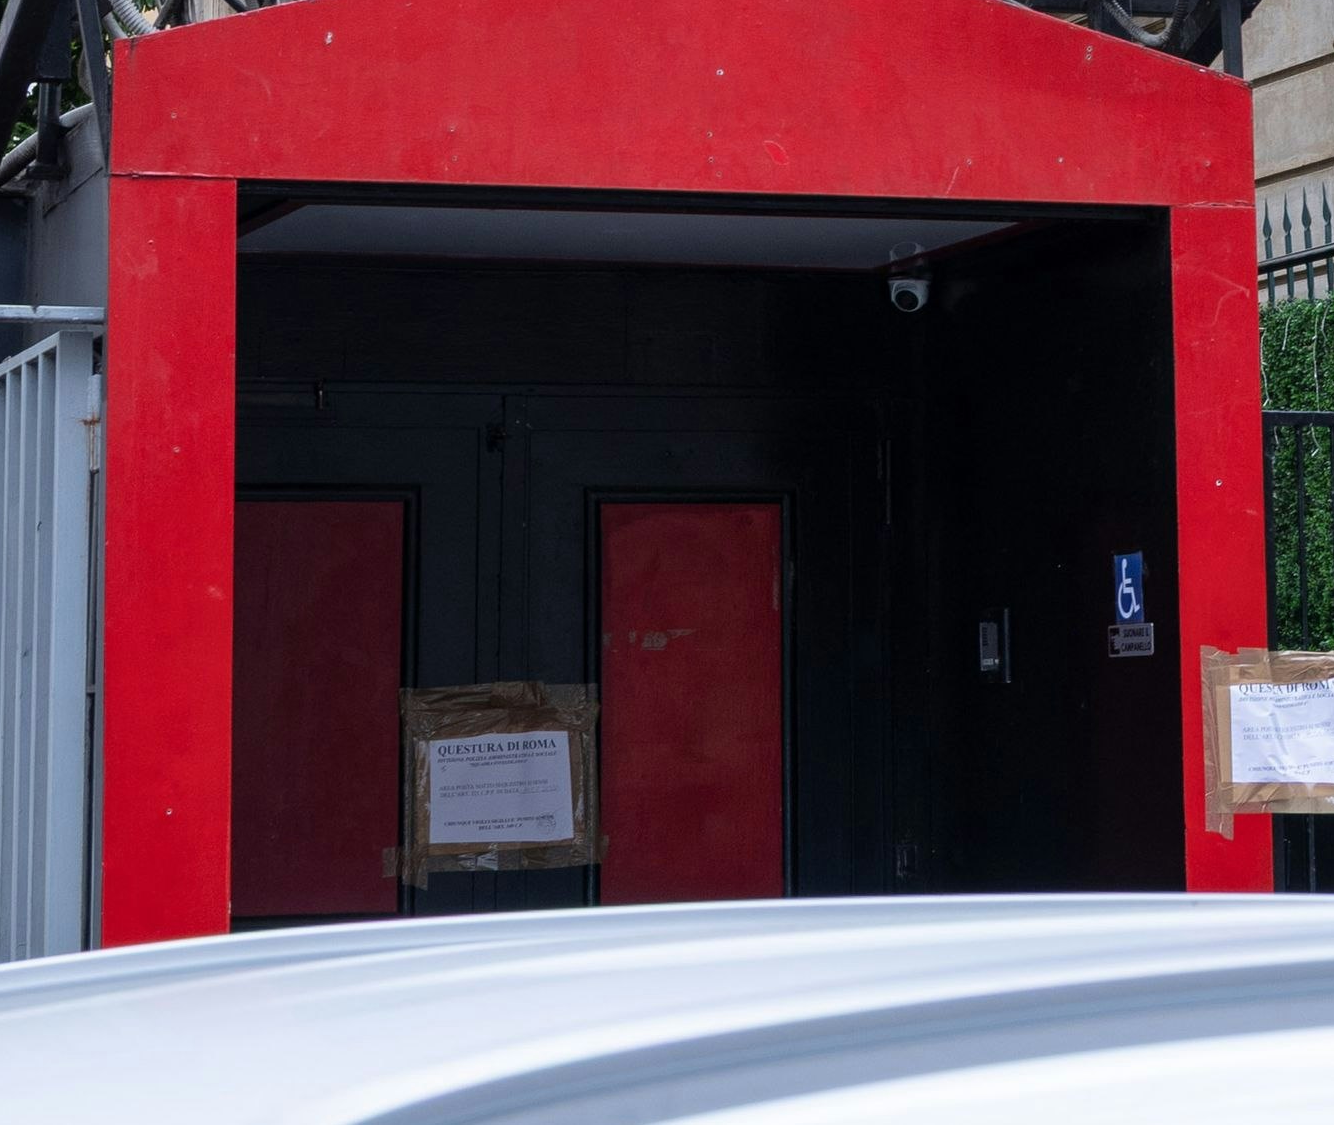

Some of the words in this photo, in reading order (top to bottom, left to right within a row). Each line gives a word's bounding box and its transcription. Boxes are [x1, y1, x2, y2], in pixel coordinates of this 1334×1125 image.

[1120, 641, 1152, 652] CAMPANELLO
[437, 742, 504, 757] QUESTURA
[507, 740, 520, 751] DI
[522, 738, 557, 750] ROMA
